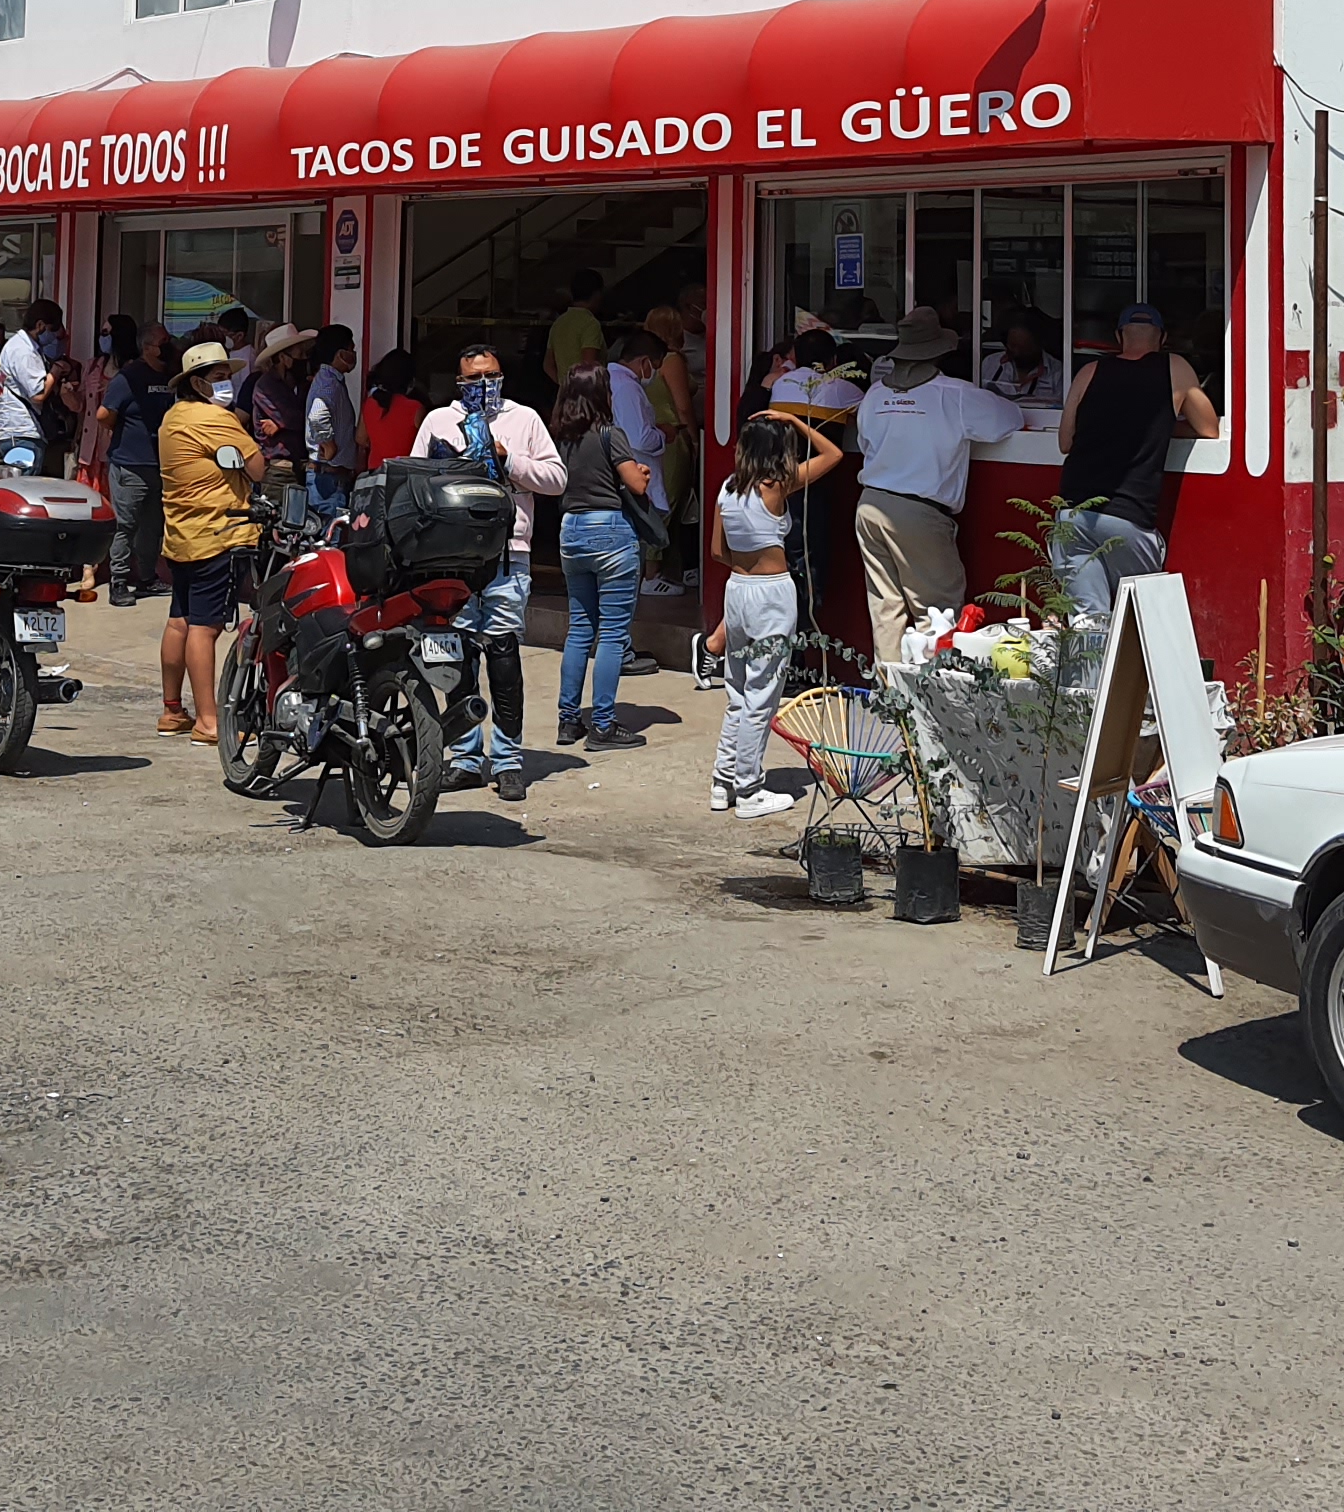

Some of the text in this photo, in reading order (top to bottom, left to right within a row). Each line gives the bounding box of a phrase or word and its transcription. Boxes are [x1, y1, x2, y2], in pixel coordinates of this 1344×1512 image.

[59, 138, 92, 190] DE
[100, 128, 188, 186] TODOS
[290, 83, 1073, 179] TACOS DE GUISADO EL GÜERO
[339, 220, 355, 237] ADT
